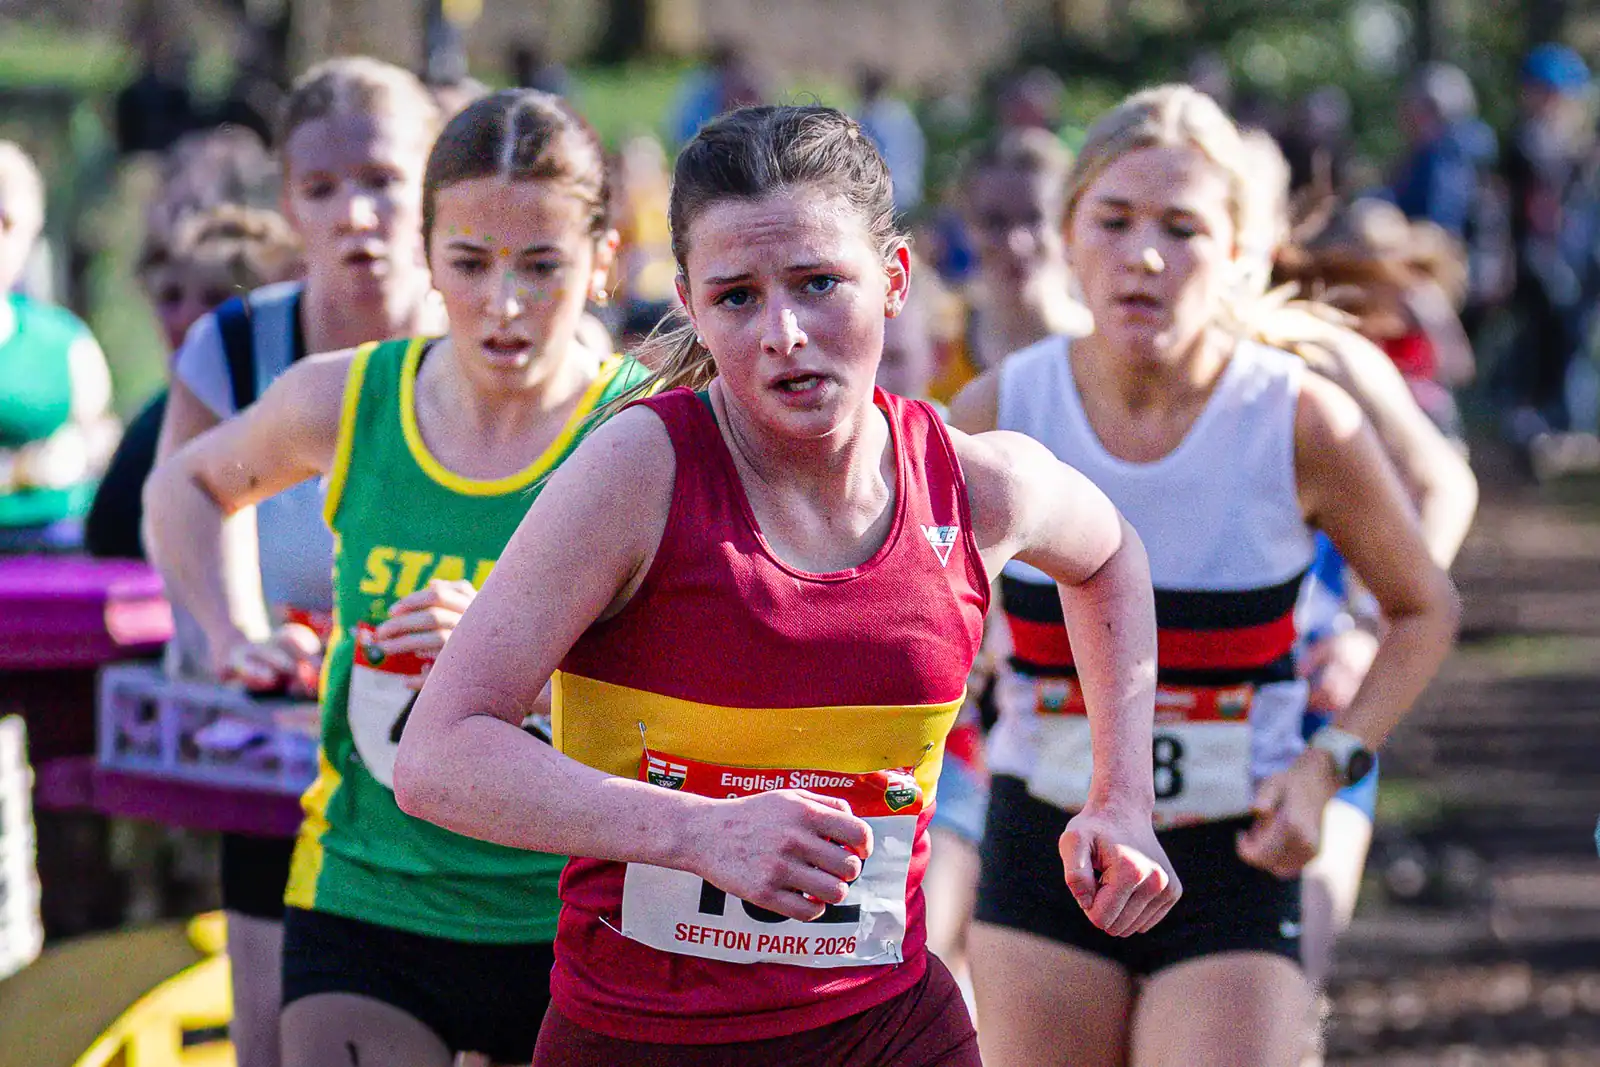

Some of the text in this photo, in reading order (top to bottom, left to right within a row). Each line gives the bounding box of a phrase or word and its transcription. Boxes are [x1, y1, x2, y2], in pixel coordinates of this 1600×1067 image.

[720, 771, 856, 791] English Schools
[674, 922, 857, 956] SEFTON PARK 2026
